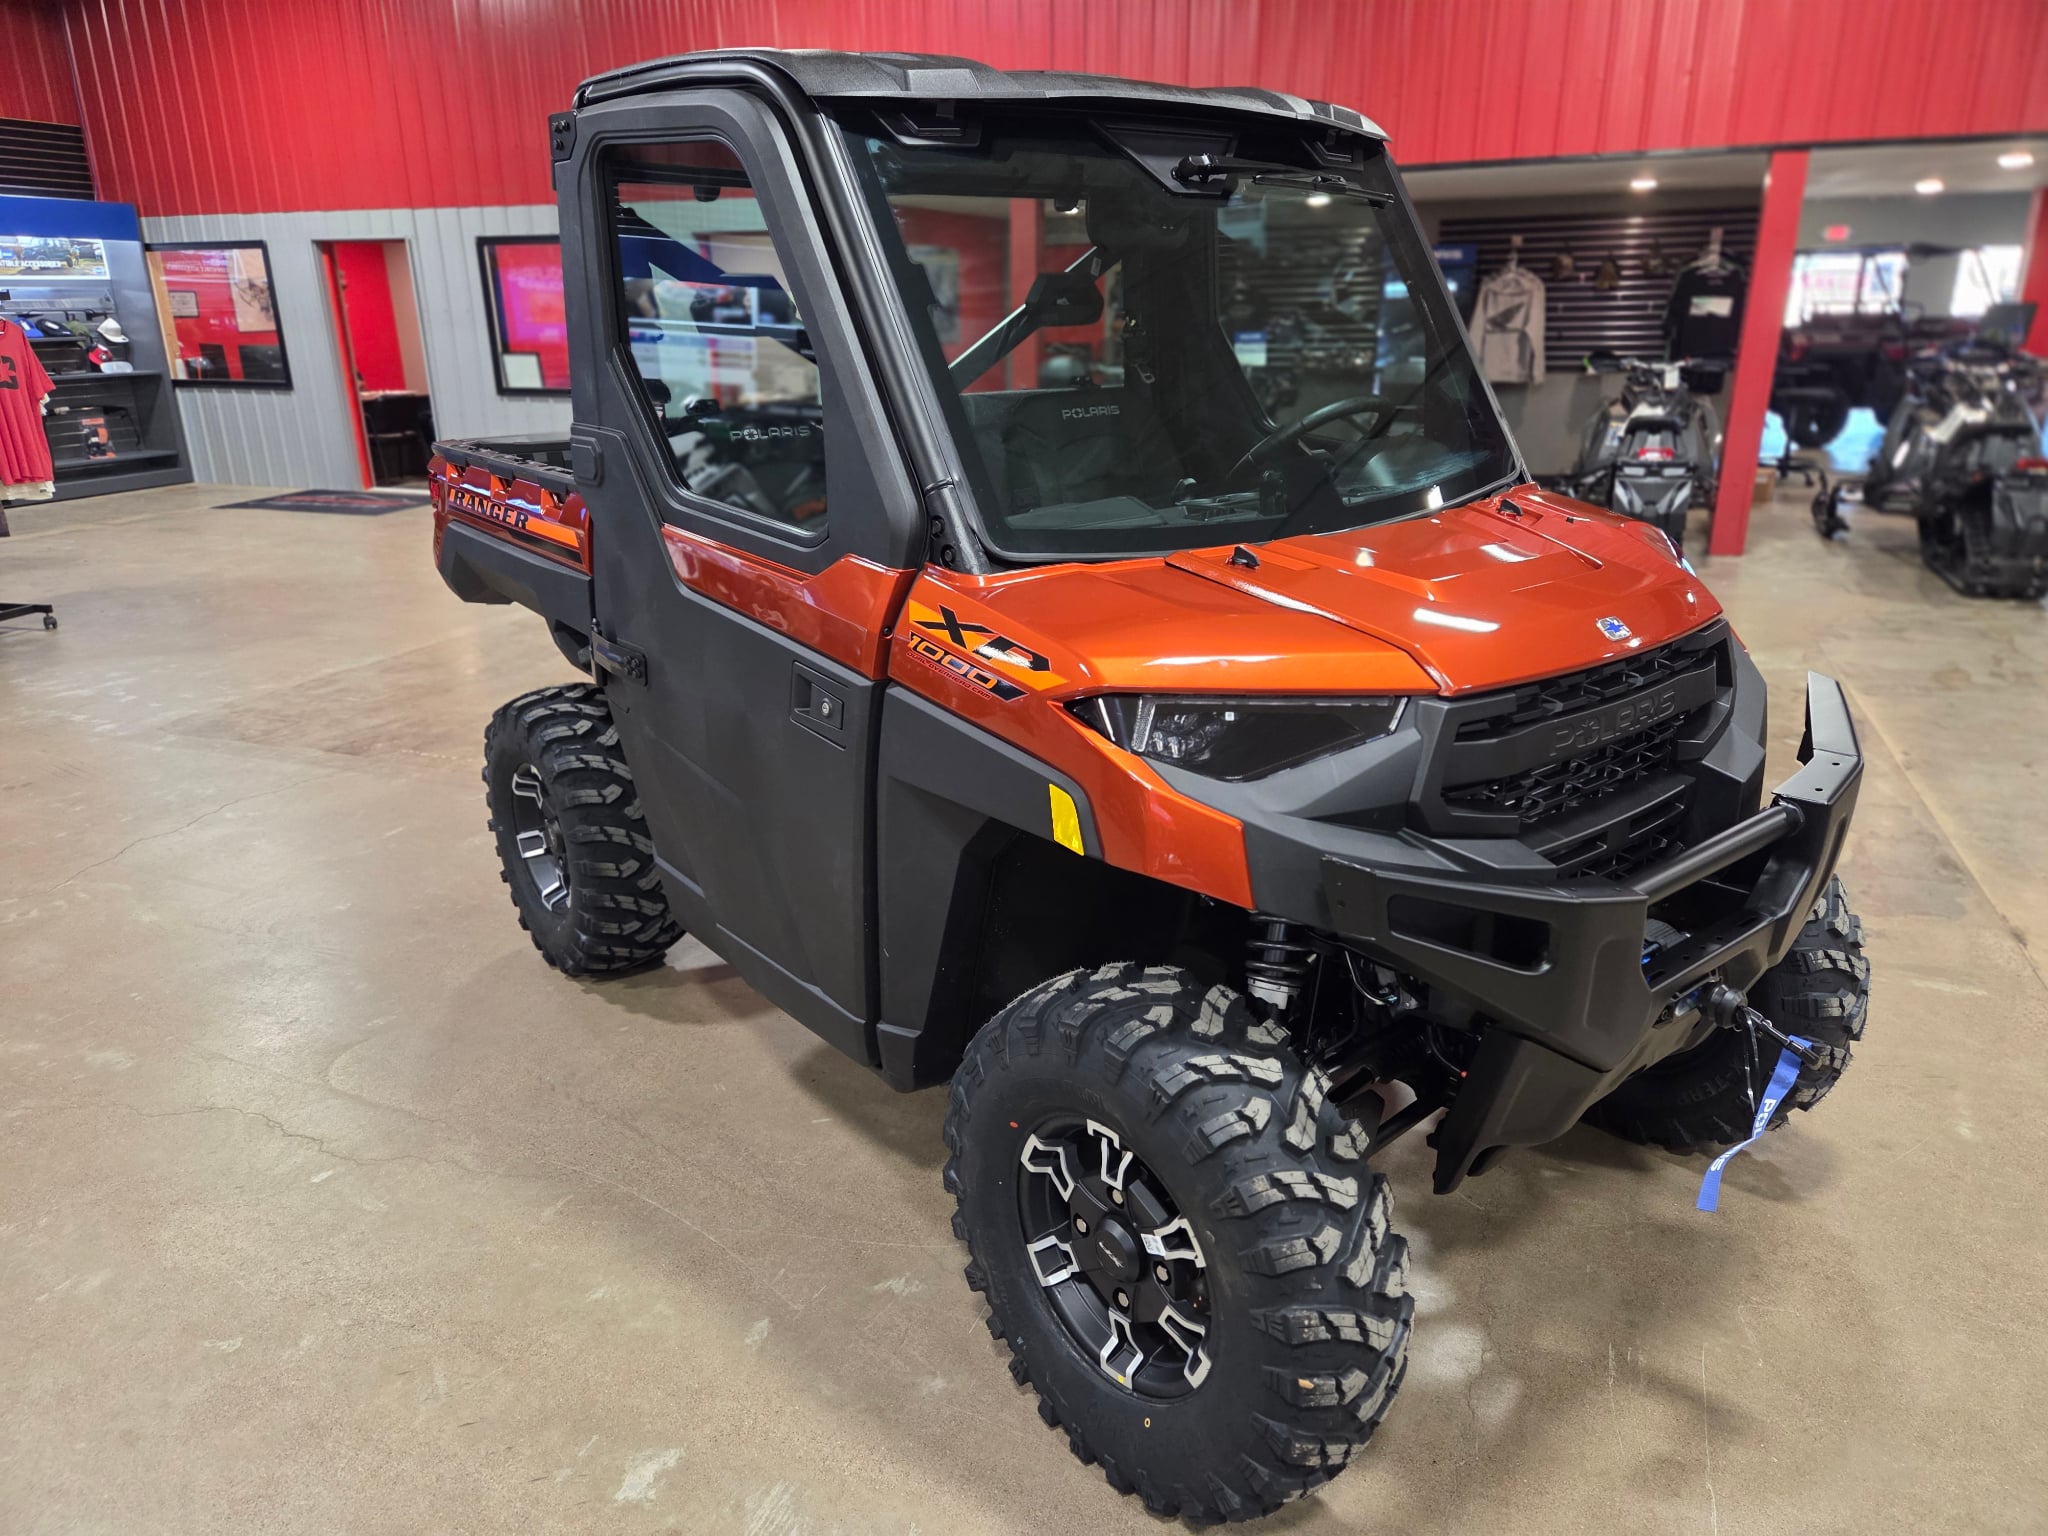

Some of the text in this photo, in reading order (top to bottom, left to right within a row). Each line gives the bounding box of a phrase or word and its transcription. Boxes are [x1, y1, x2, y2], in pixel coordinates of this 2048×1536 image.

[1062, 404, 1120, 420] POLARIS
[729, 425, 810, 441] POLARIS
[454, 489, 529, 530] RANGER
[907, 635, 998, 690] 1000
[971, 685, 992, 700] CAM
[1550, 690, 1676, 757] POLARIS
[1710, 1098, 1777, 1172] POLIS
